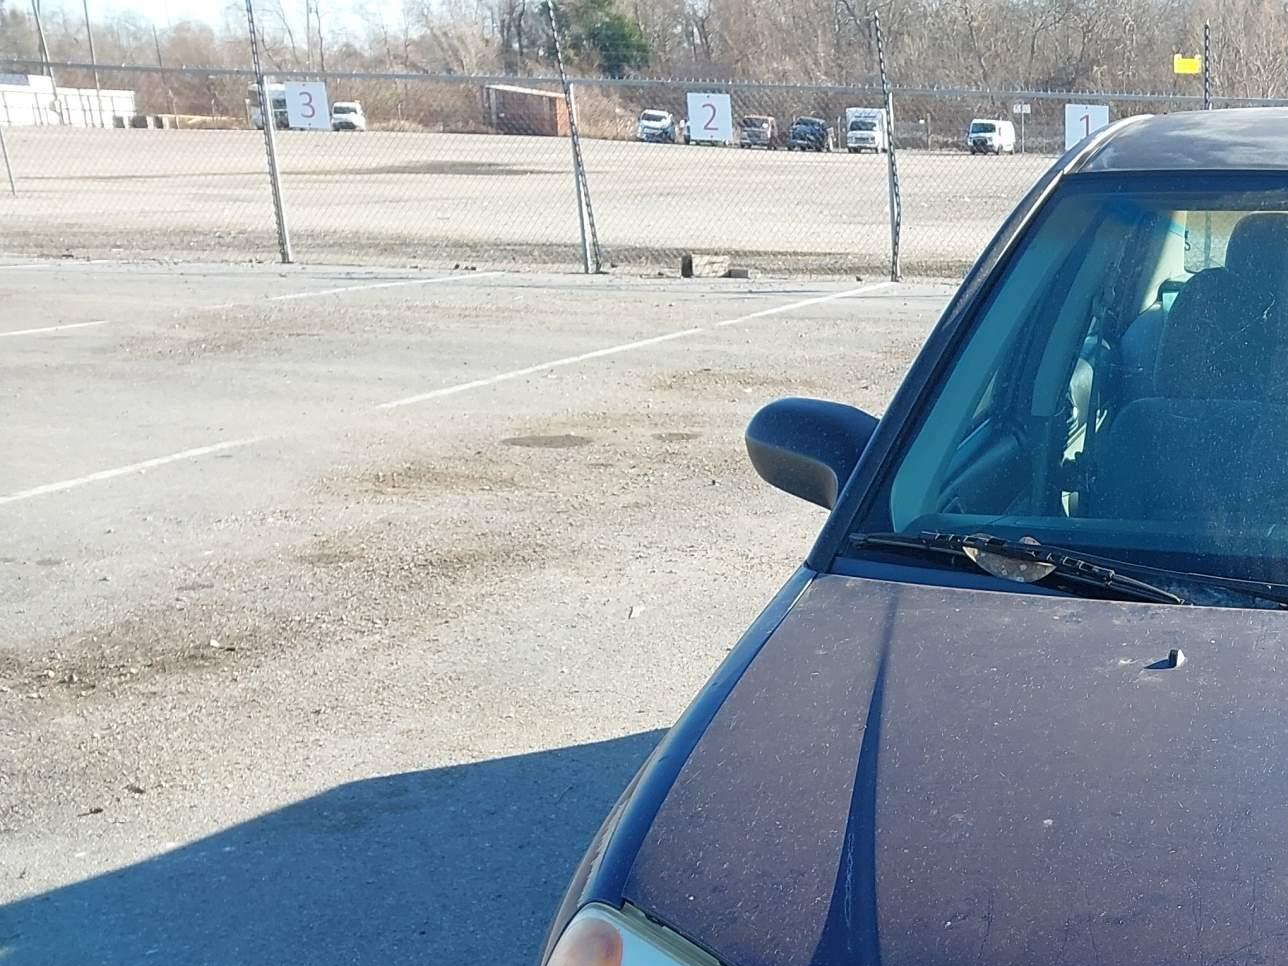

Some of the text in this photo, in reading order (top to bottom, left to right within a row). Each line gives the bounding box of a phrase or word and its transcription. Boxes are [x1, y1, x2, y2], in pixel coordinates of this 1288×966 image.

[299, 91, 315, 118] 3
[702, 103, 719, 131] 2
[1080, 114, 1089, 137] 1
